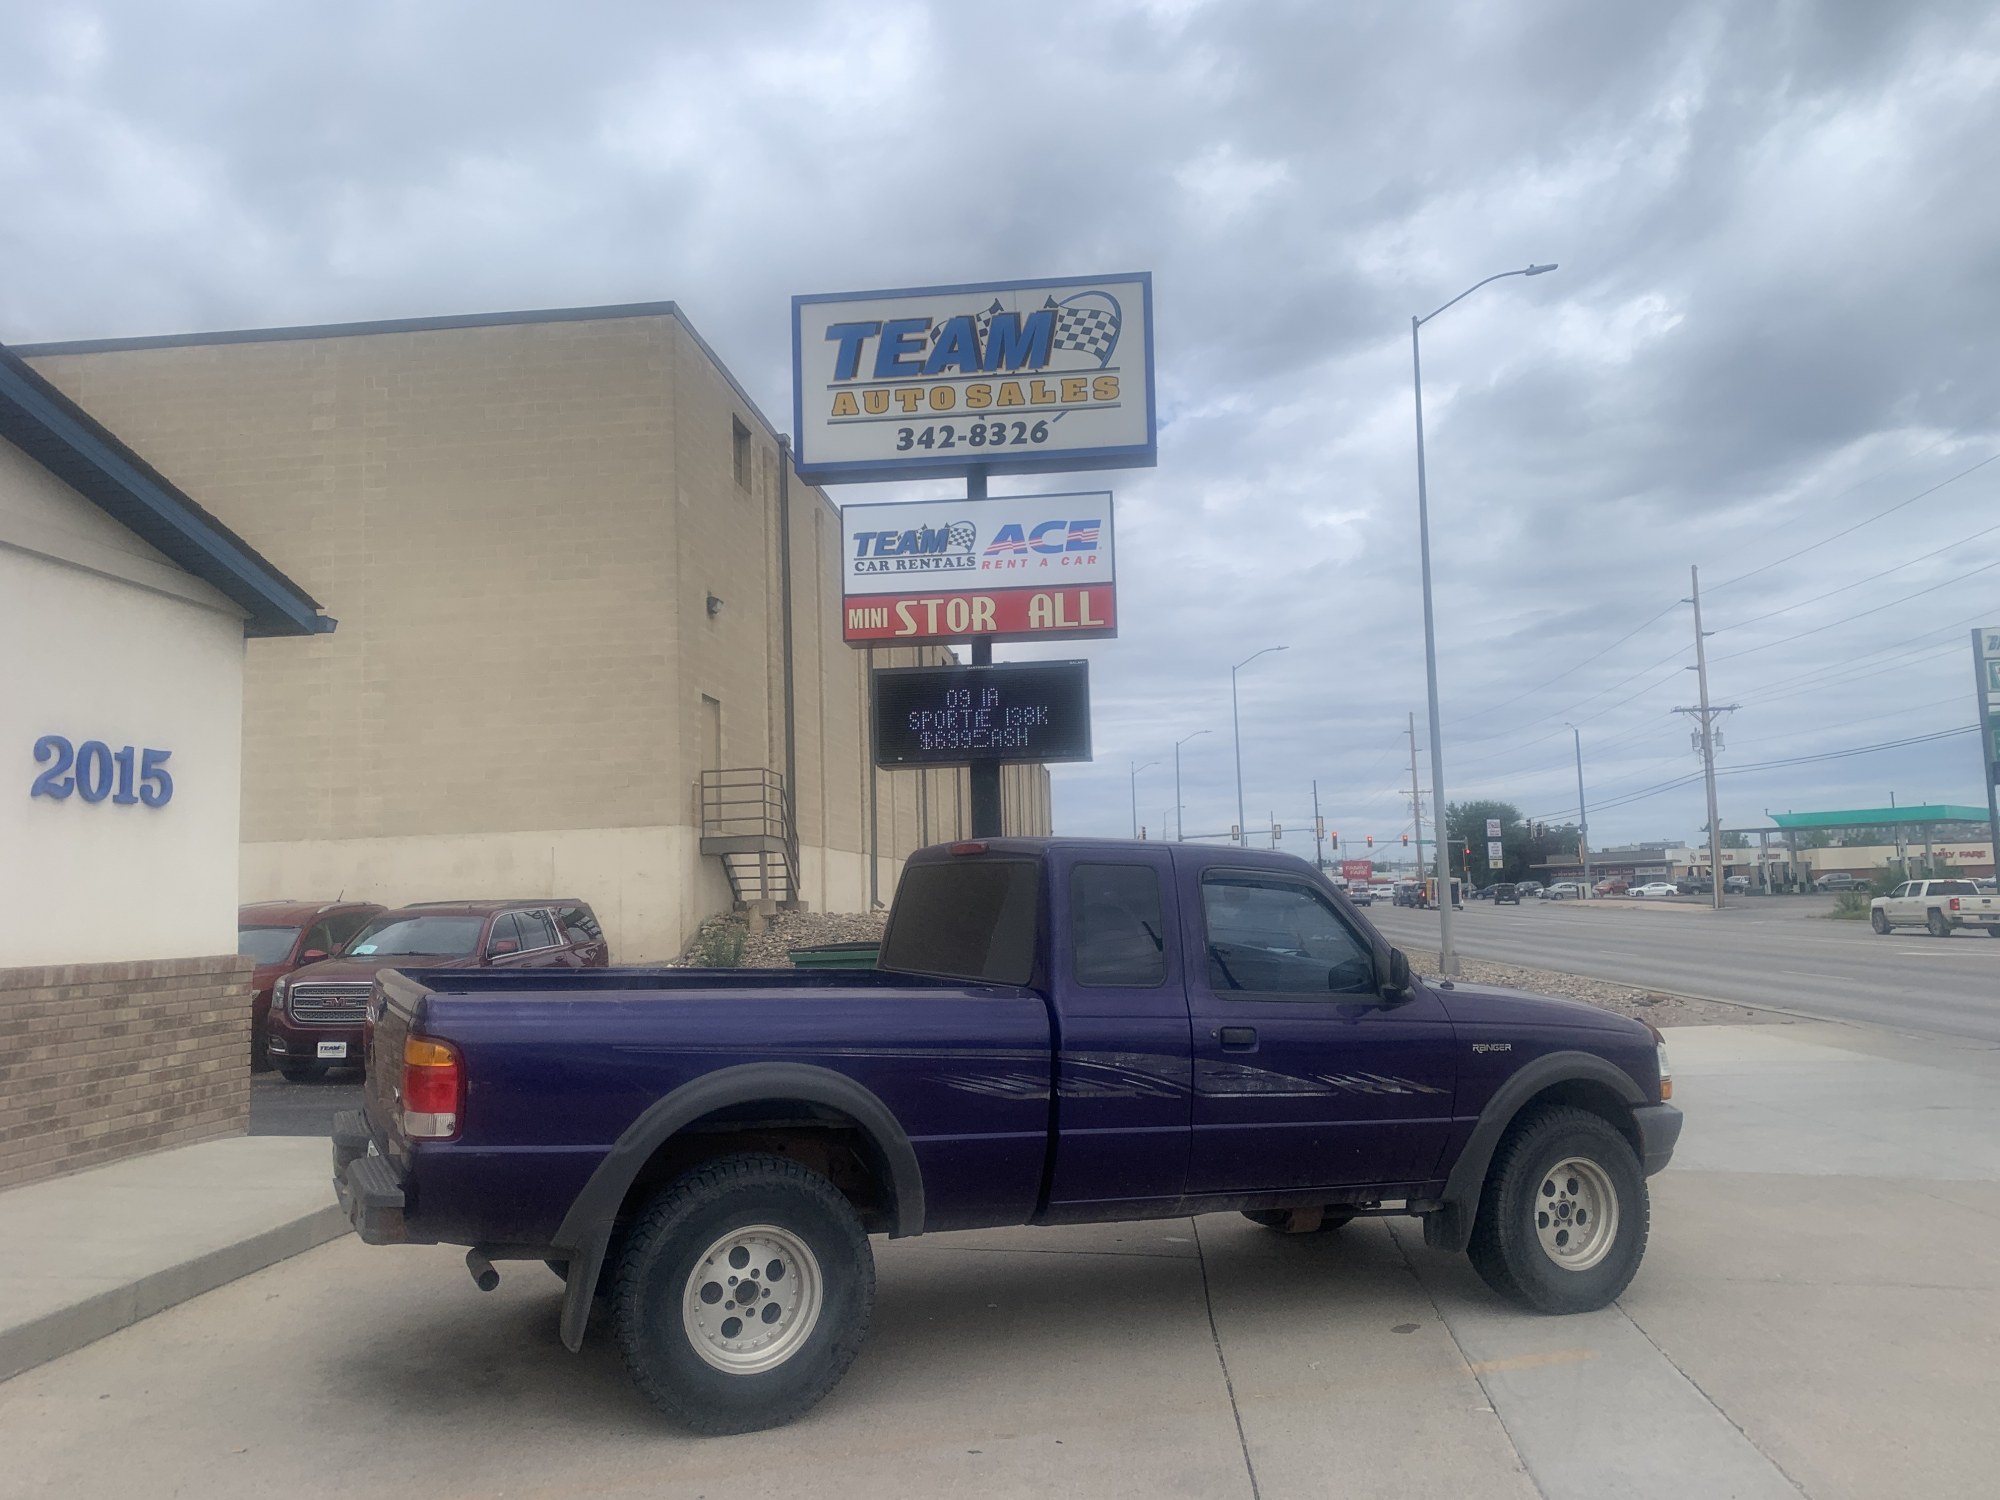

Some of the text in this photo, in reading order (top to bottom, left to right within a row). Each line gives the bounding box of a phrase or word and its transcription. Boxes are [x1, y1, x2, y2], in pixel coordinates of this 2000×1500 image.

[825, 308, 1058, 381] TEAM
[831, 376, 1120, 416] AUTO SALES
[896, 420, 1049, 451] 342-8326
[853, 528, 950, 557] TEAM
[982, 519, 1102, 556] ACE
[854, 556, 976, 572] CAR RENTALS
[981, 555, 1097, 570] RENT A CAR
[848, 591, 1105, 635] MINI STOR ALL
[946, 689, 970, 708] 09
[1006, 706, 1048, 726] 138K
[31, 735, 174, 808] 2015
[321, 997, 356, 1008] GMC
[1472, 1043, 1512, 1054] RANGER
